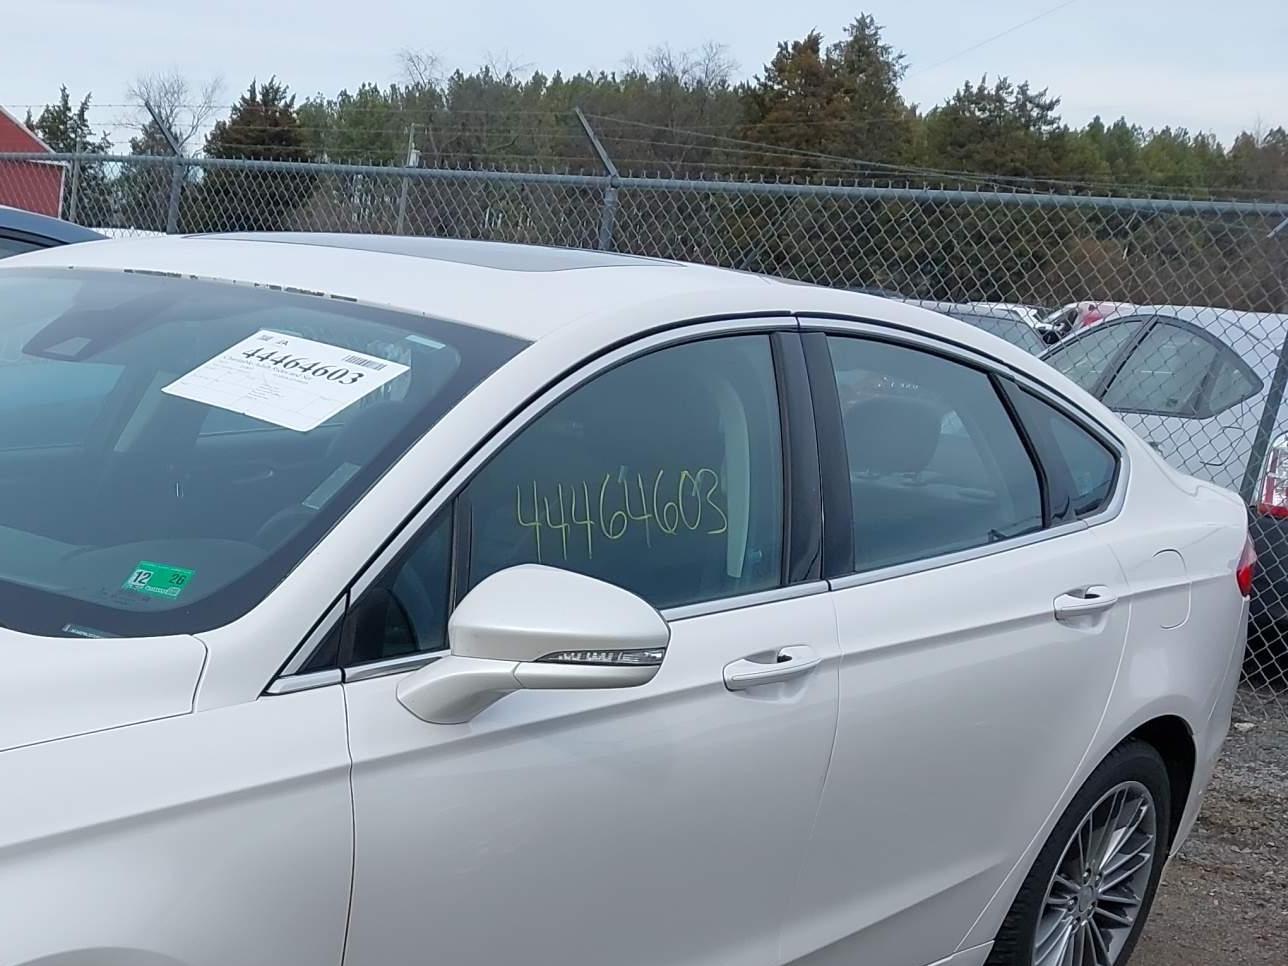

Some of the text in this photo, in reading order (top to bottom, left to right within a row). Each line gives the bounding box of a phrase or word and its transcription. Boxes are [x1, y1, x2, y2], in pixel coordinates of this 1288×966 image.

[242, 347, 364, 385] 44464603
[517, 468, 728, 563] 44464603
[132, 570, 152, 585] 12
